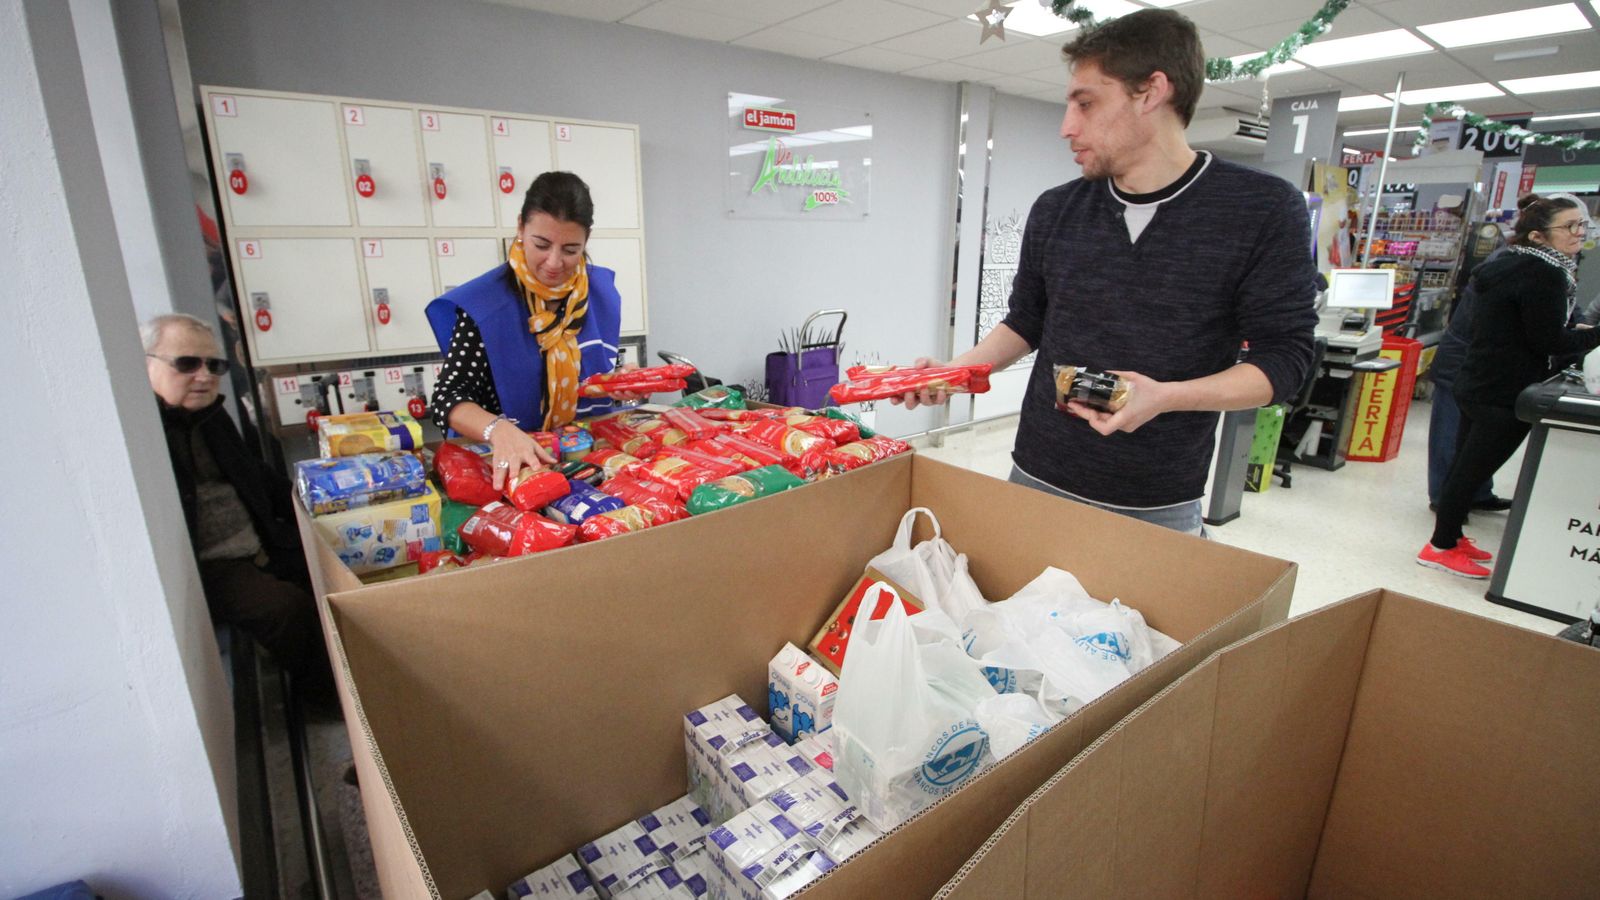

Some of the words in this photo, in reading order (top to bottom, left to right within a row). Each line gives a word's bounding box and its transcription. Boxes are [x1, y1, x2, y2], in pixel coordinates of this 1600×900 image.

[221, 100, 230, 113] 1
[1290, 100, 1319, 111] CAJA
[349, 109, 358, 123] 2
[426, 116, 434, 128] 3
[746, 110, 757, 123] el
[759, 112, 794, 127] jamón
[497, 121, 504, 134] 4
[559, 127, 567, 138] 5
[1292, 114, 1309, 154] 1
[231, 177, 244, 189] 01
[358, 181, 373, 192] 02
[500, 178, 512, 188] 04
[814, 191, 838, 202] 100%
[245, 243, 255, 256] 6
[368, 243, 377, 255] 7
[441, 243, 449, 254] 8
[387, 370, 400, 381] 13
[283, 380, 297, 391] 11
[411, 404, 421, 412] 13
[1567, 518, 1600, 536] PA
[914, 771, 939, 796] BANCOS
[773, 843, 801, 866] VAQUERA
[787, 853, 798, 863] LA
